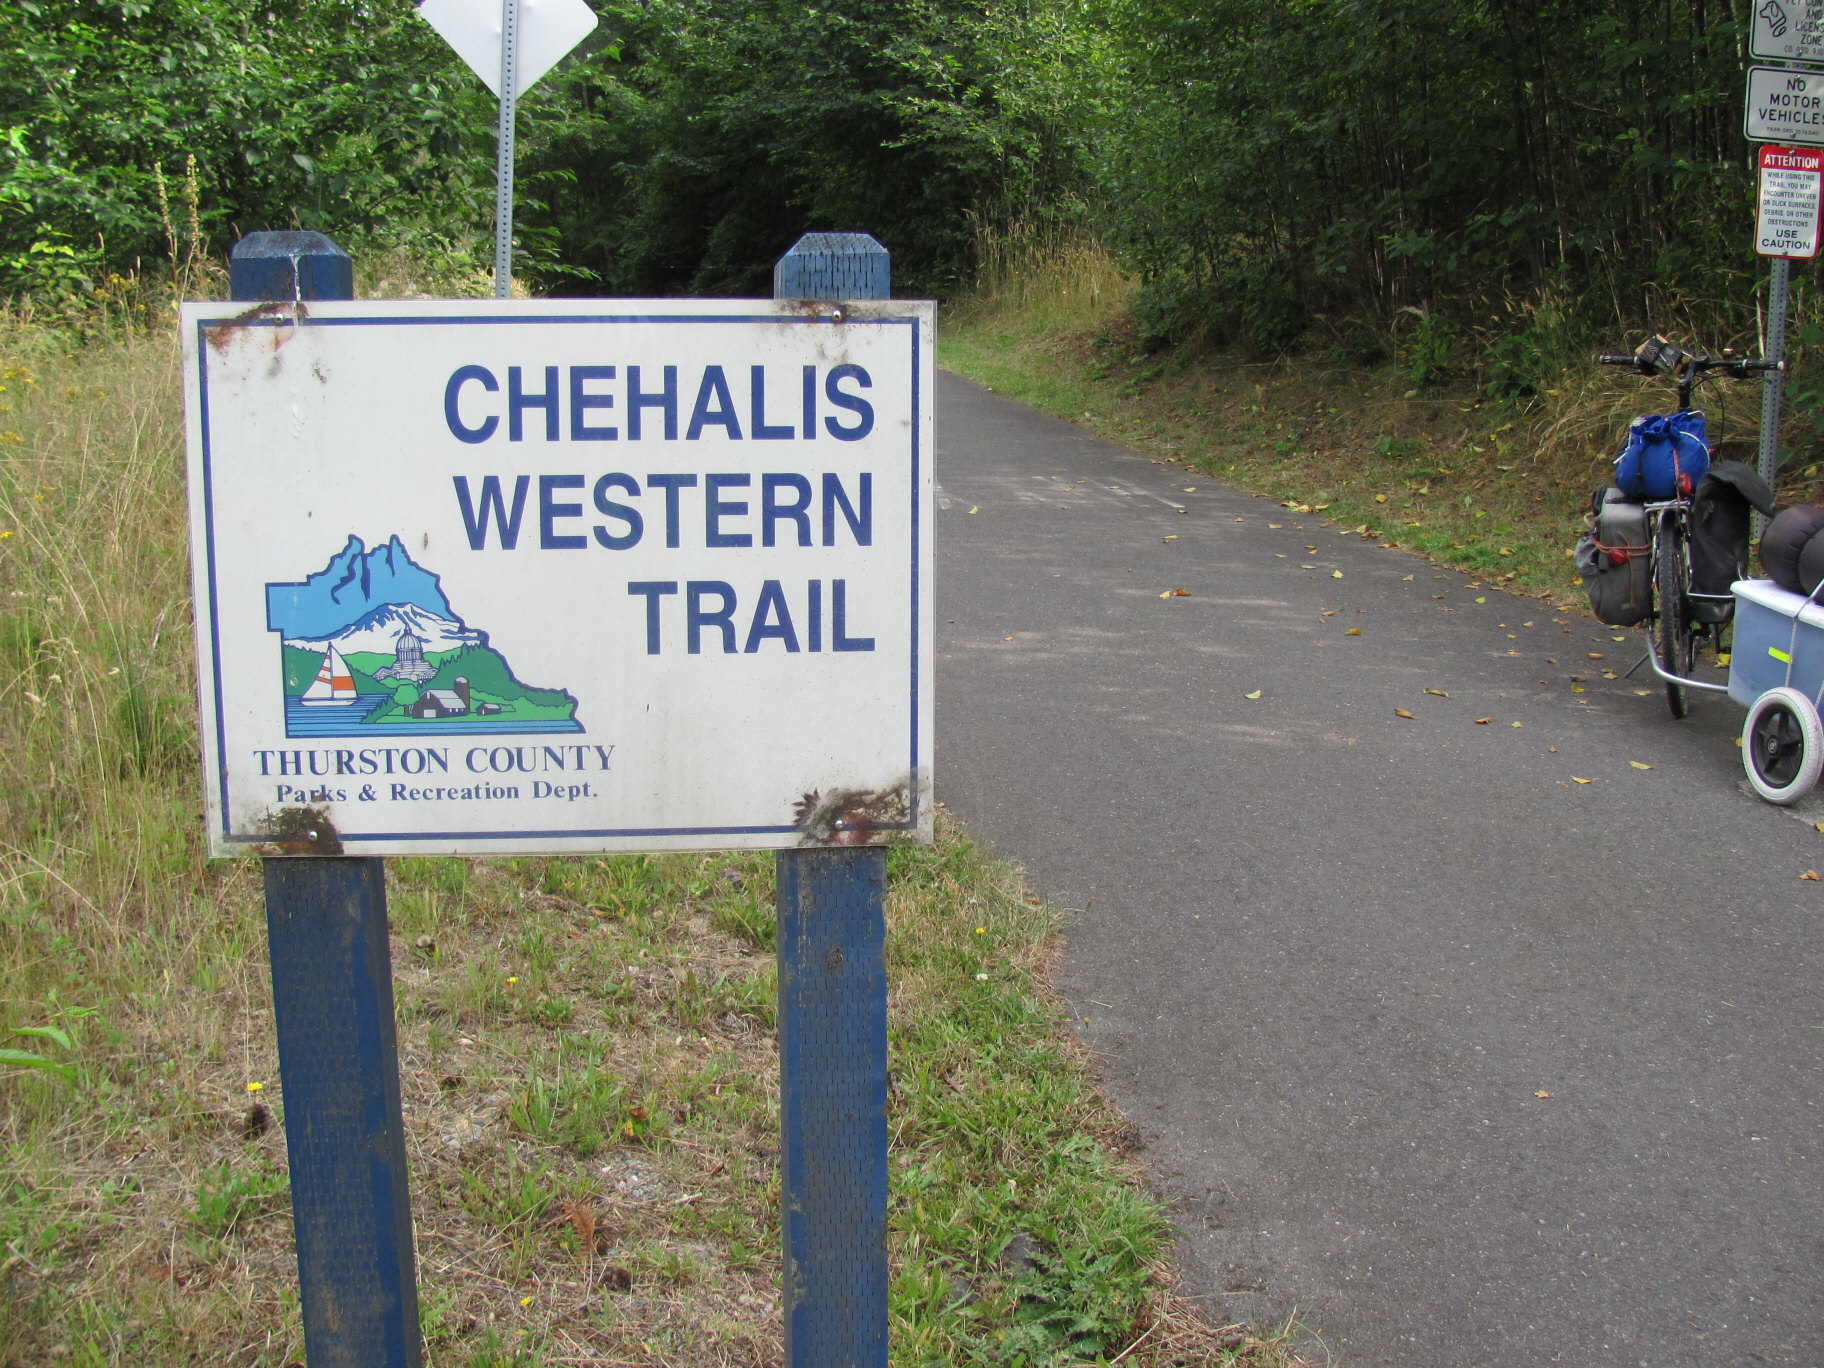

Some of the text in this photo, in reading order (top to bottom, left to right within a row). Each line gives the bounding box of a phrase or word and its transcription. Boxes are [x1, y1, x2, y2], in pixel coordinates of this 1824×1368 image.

[1800, 33, 1822, 46] ZONE
[1786, 78, 1806, 92] NO
[1769, 92, 1821, 109] MOTOR
[1764, 154, 1819, 169] ATTENTION
[1767, 171, 1815, 182] WHILE USING THIS
[1787, 182, 1799, 190] YOU
[1799, 183, 1812, 191] MAY
[1795, 211, 1814, 219] OTHER
[1767, 218, 1809, 228] OBSTRUCTIONS
[1776, 229, 1798, 239] USE
[1761, 238, 1811, 250] CAUTION
[444, 363, 875, 444] CHEHALIS
[452, 472, 873, 551] WESTERN
[627, 578, 876, 655] TRAIL
[253, 745, 616, 776] THURSTON COUNTY
[276, 779, 599, 804] Parks & Recreation Dept.
